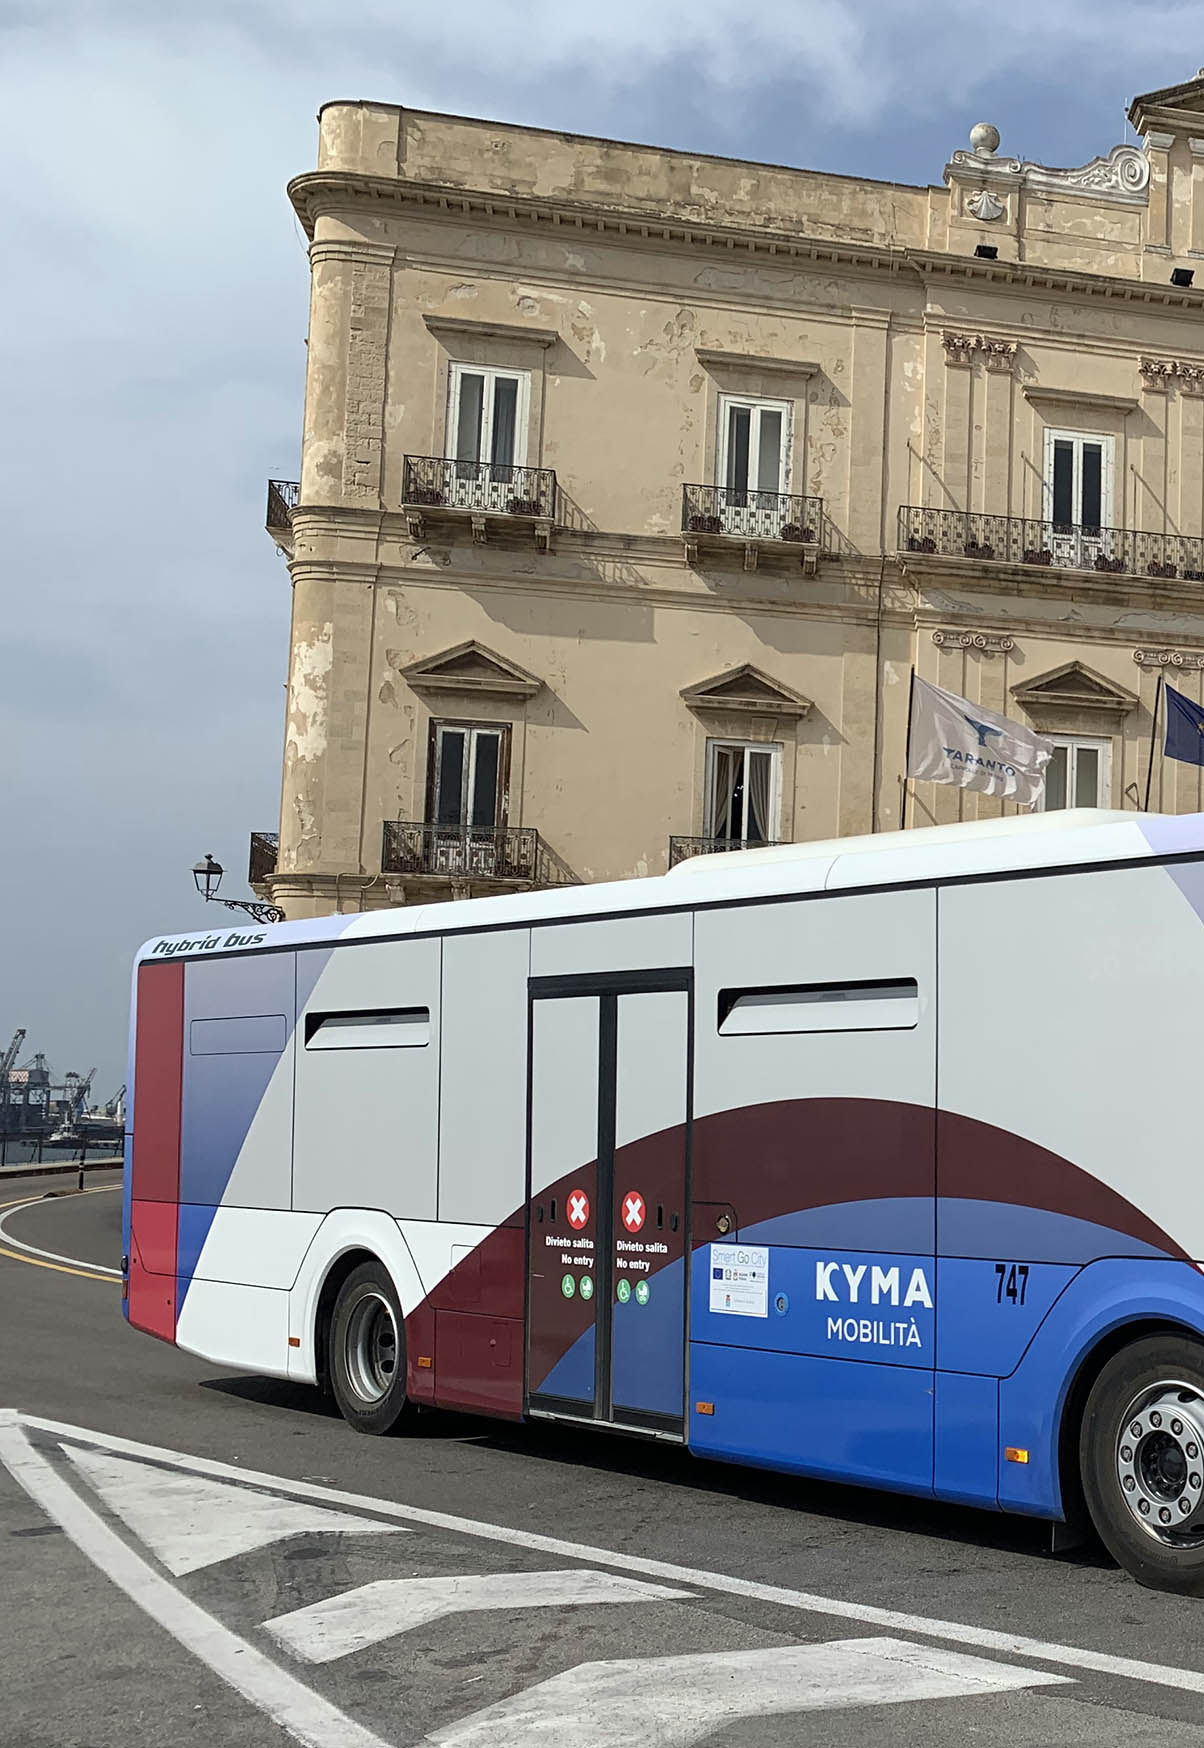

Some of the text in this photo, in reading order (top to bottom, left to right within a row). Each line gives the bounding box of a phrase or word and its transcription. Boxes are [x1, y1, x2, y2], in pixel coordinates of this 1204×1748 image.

[943, 747, 1016, 777] TARANTO
[152, 933, 267, 956] hybrid bus
[545, 1235, 594, 1249] Divieto salita
[616, 1240, 668, 1254] Divieto salita
[561, 1253, 594, 1269] No entry
[616, 1257, 650, 1272] No entry
[737, 1250, 750, 1265] Go
[815, 1261, 934, 1309] KYMA
[995, 1263, 1029, 1306] 747
[827, 1317, 922, 1348] MOBILITÀ
